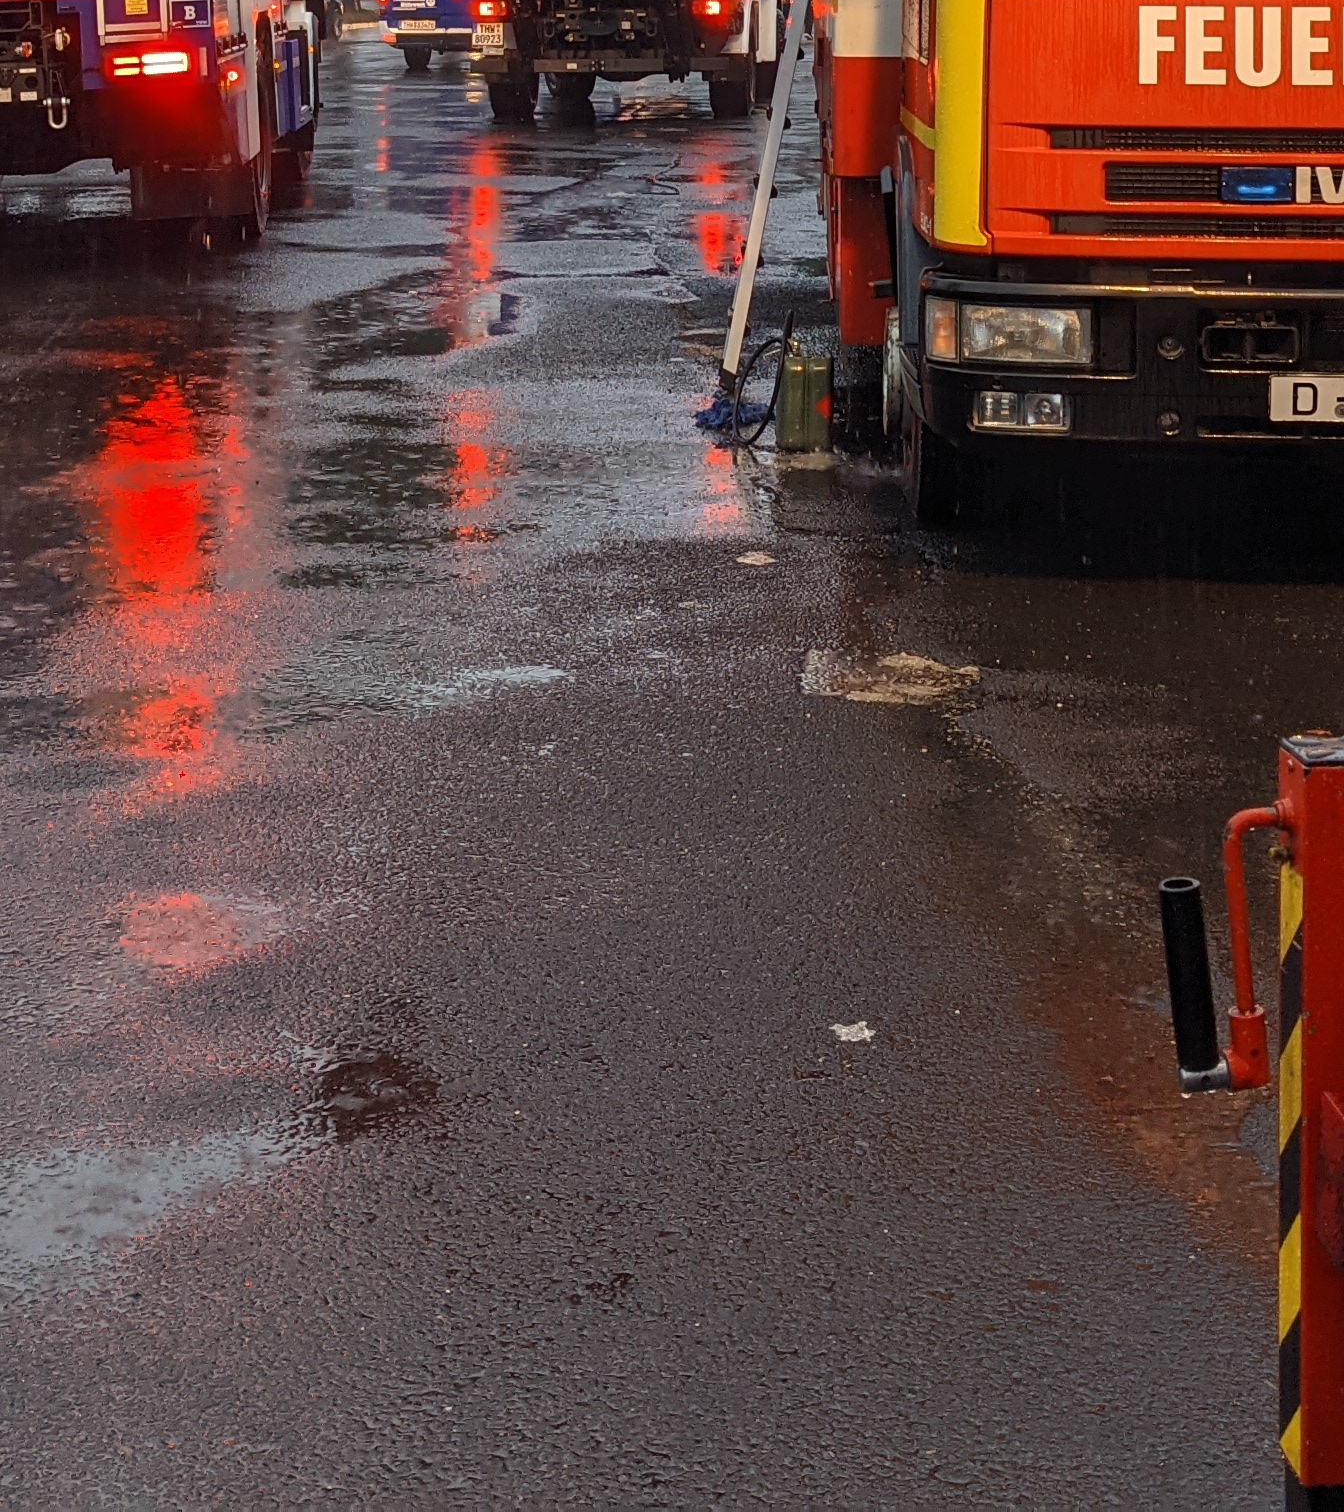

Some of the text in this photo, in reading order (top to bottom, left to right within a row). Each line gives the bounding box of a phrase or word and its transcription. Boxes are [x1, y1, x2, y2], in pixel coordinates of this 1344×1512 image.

[183, 5, 197, 21] B
[480, 24, 495, 34] THW
[1292, 382, 1318, 416] D
